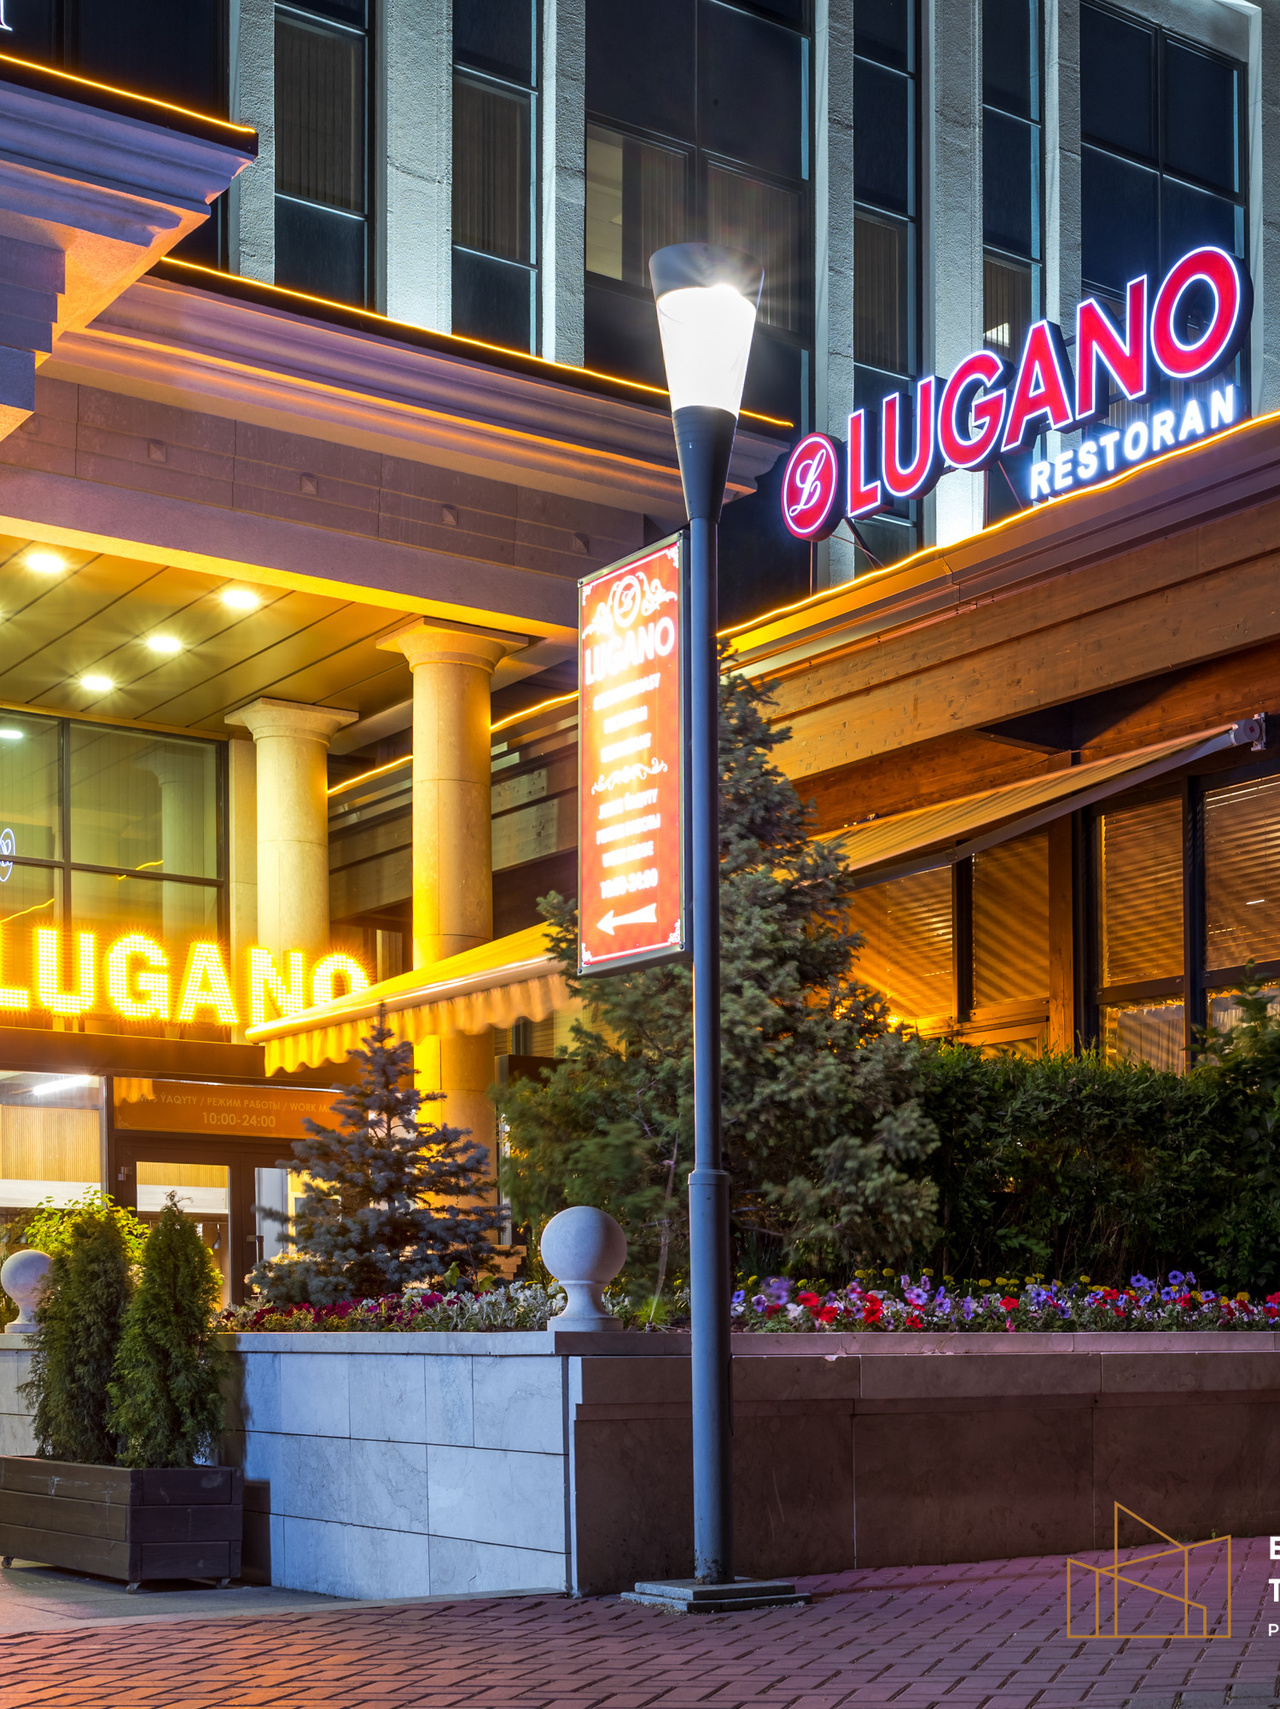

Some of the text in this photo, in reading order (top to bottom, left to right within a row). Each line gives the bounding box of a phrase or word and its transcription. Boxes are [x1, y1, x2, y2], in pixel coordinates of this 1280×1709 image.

[846, 245, 1242, 519] LUGANO
[1030, 383, 1235, 500] RESTORAN
[585, 616, 675, 685] LUGANO
[0, 928, 370, 1026] UGANO
[202, 1112, 276, 1128] 10:00-24:00
[207, 1097, 241, 1108] РЕЖИМ
[243, 1099, 281, 1111] РАБОТЫ
[289, 1102, 316, 1112] WORK
